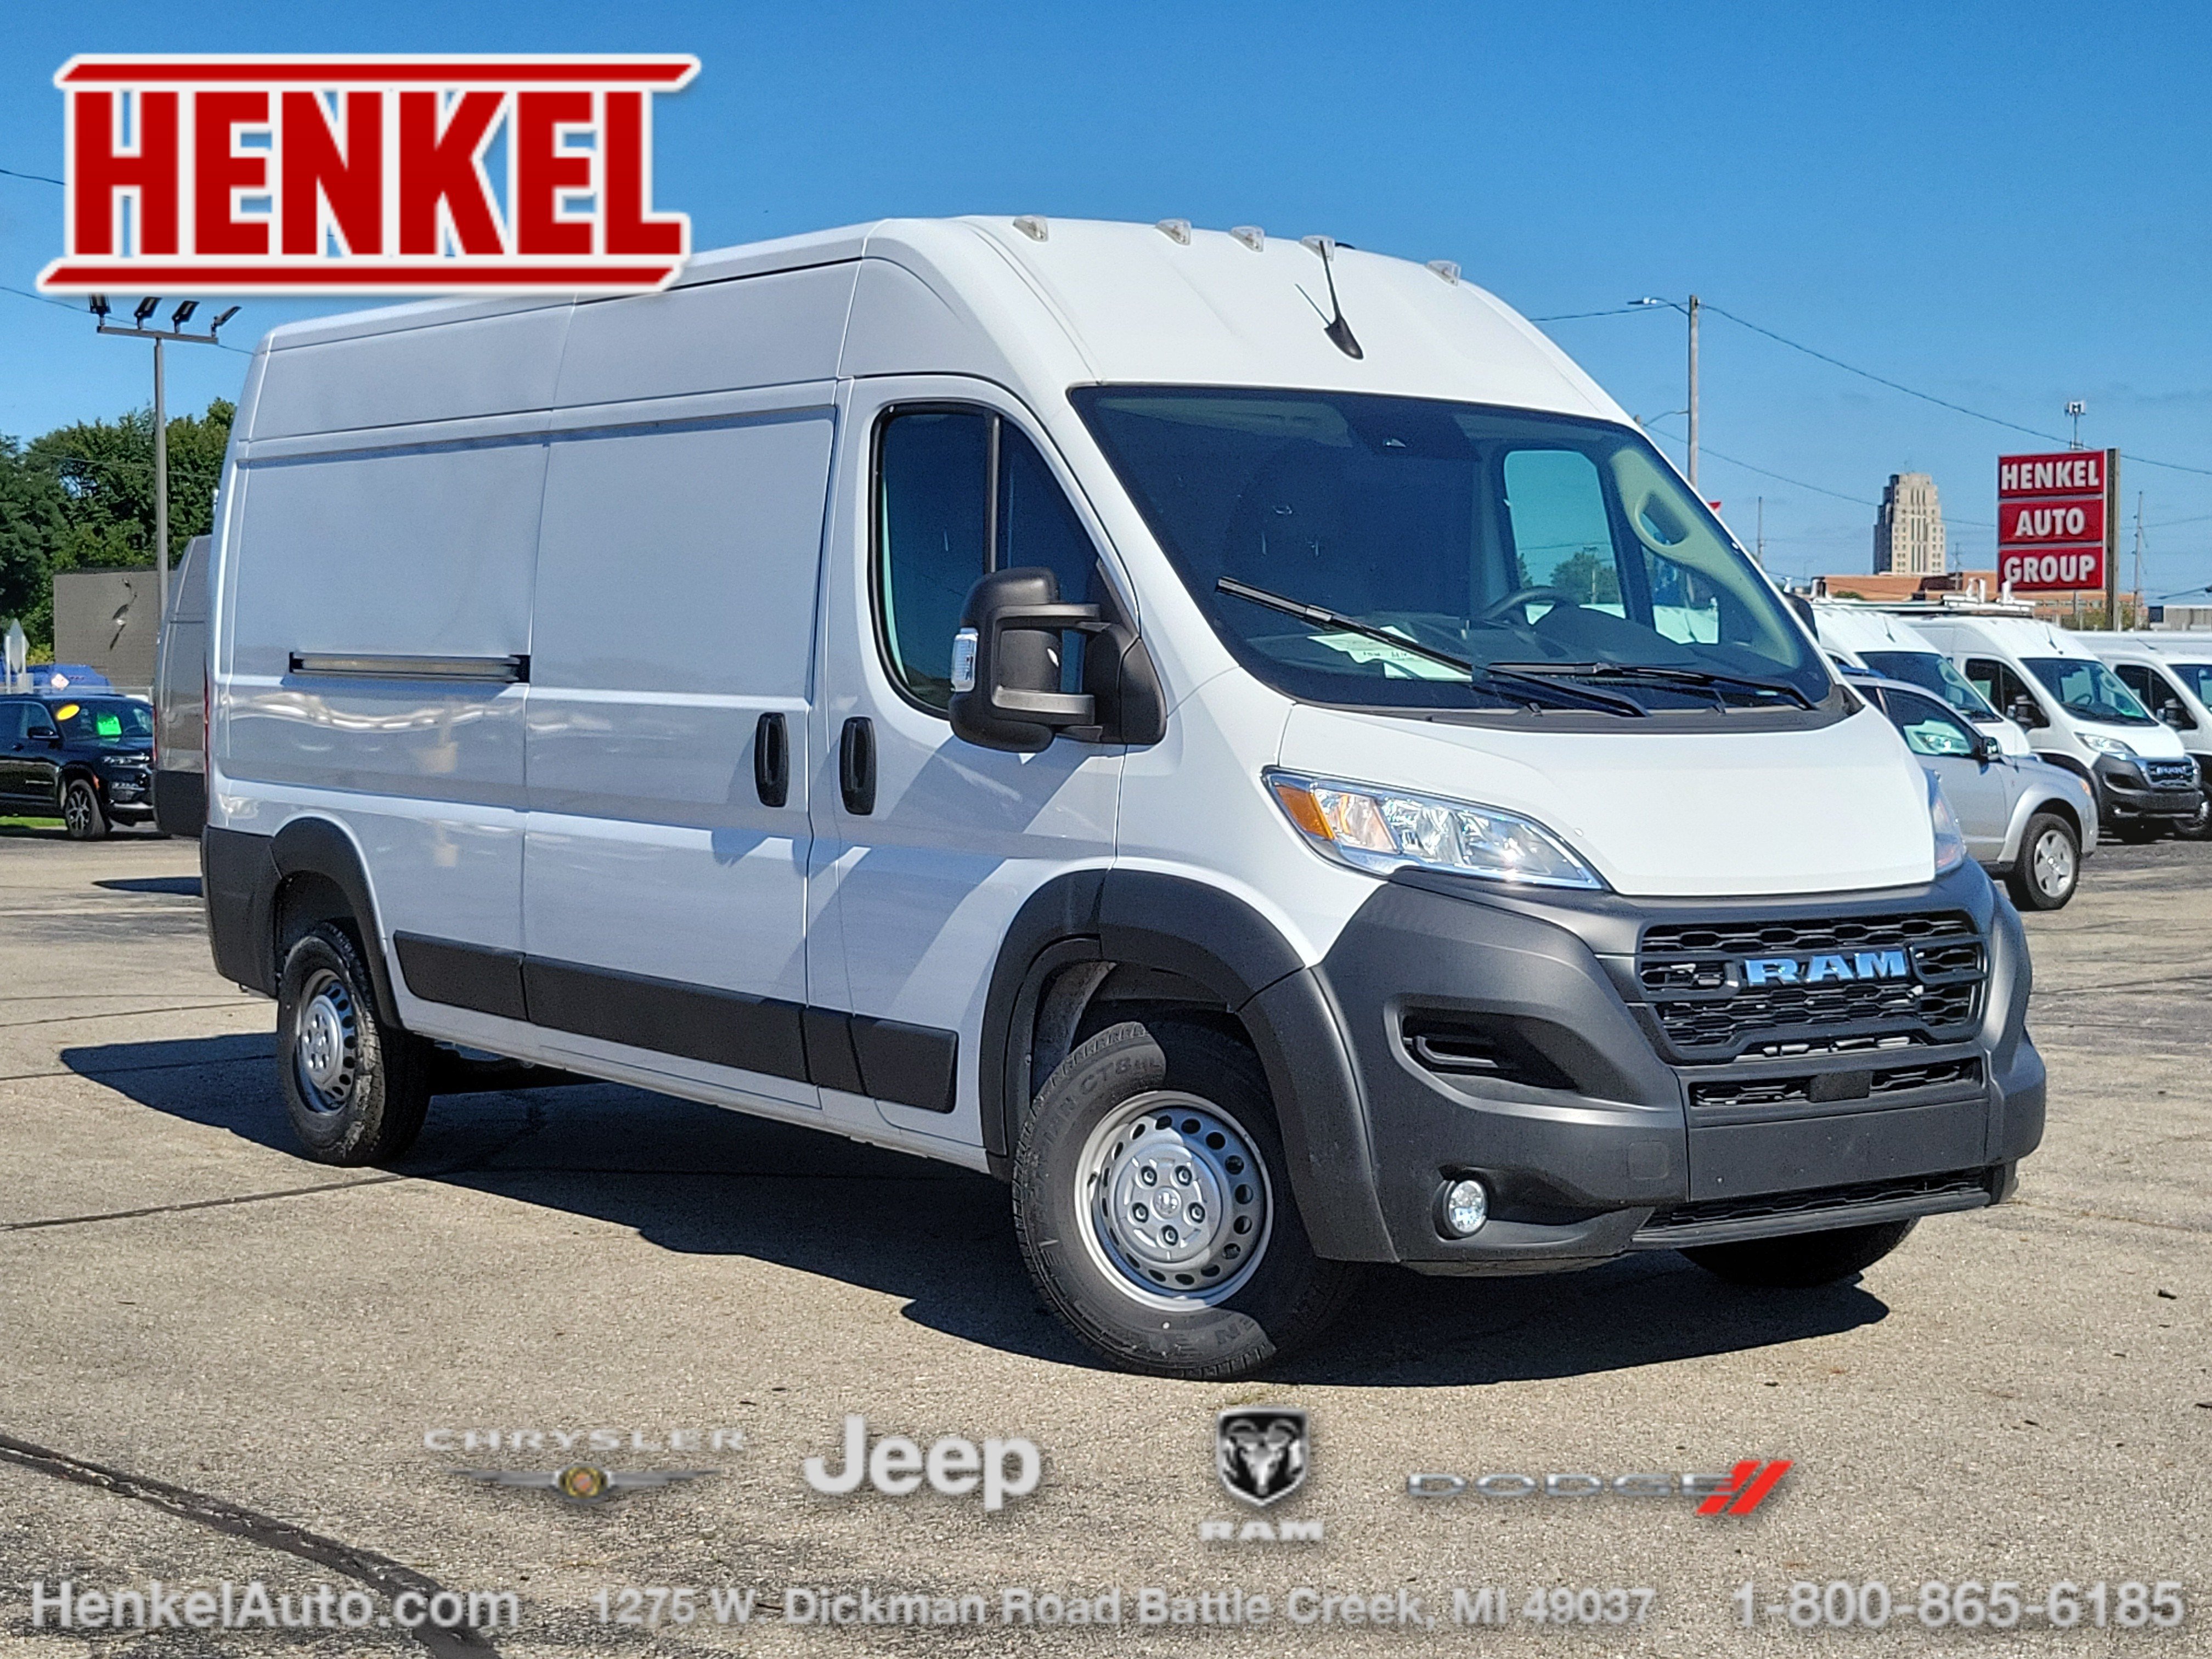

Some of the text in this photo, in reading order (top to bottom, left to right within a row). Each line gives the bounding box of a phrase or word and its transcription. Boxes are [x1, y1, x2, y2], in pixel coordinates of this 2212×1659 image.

[2001, 459, 2100, 490] HENKEL
[2015, 507, 2085, 537] AUTO
[2004, 554, 2096, 584] GROUP
[1745, 950, 1908, 987] RAM
